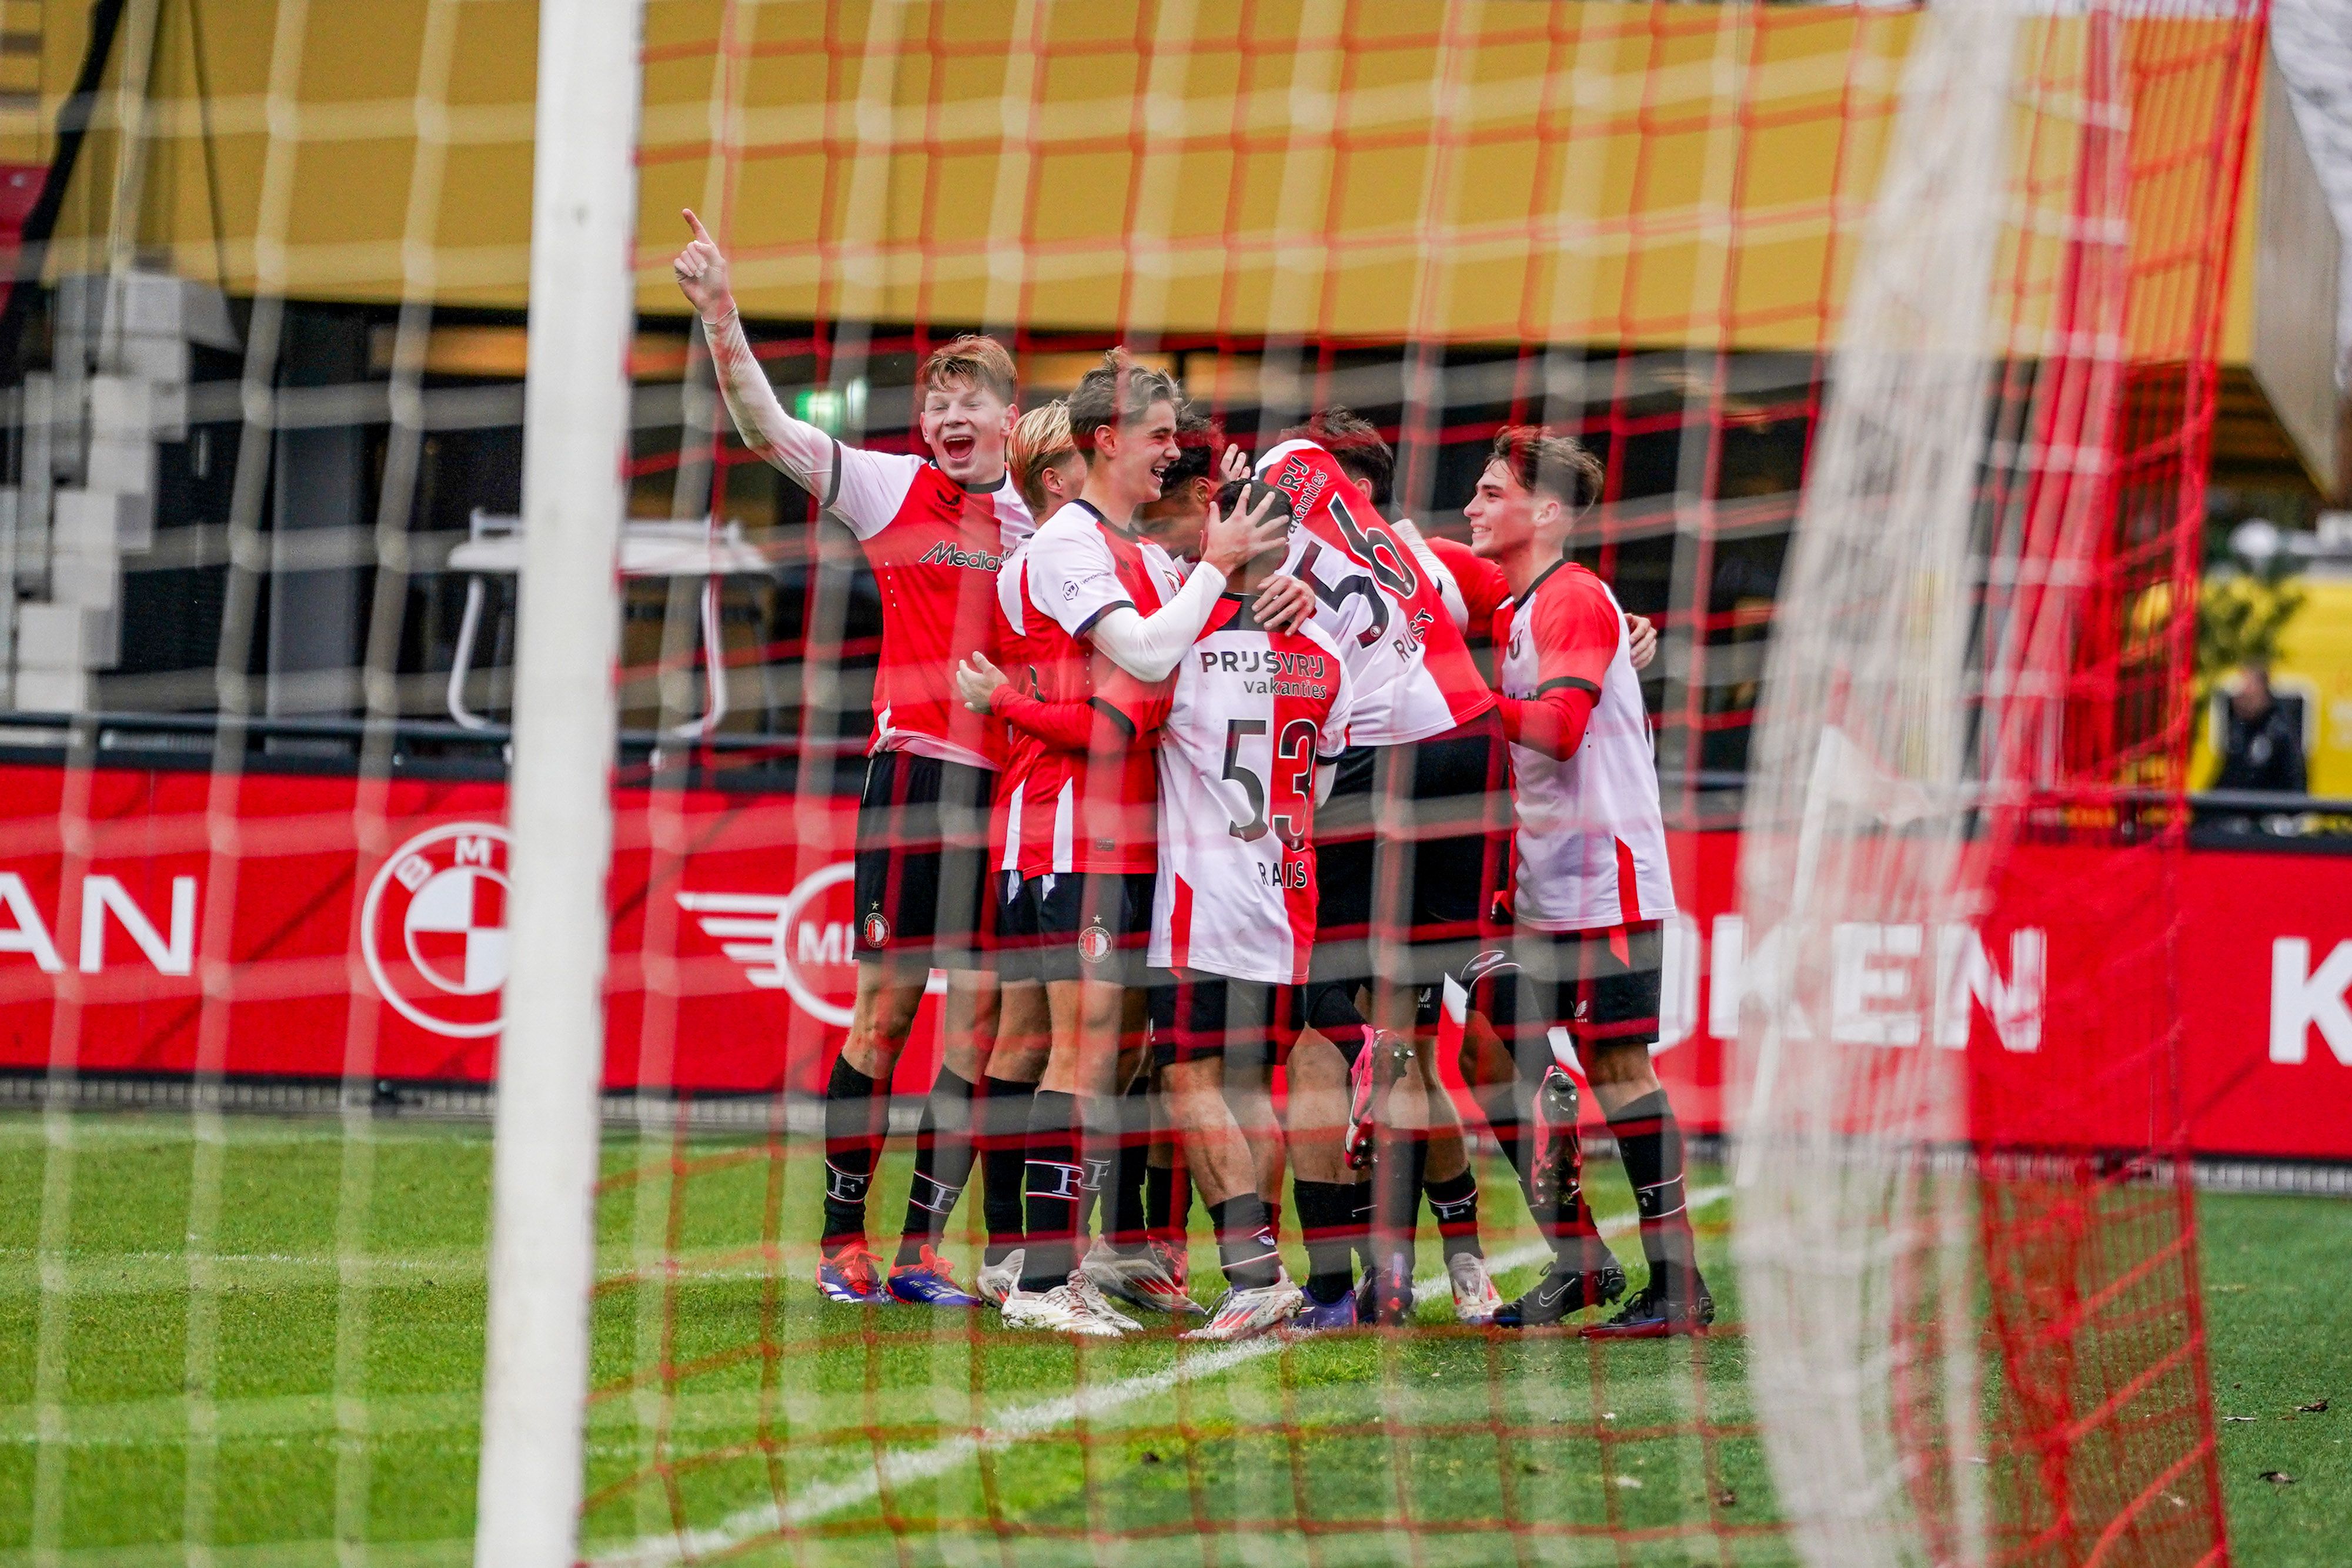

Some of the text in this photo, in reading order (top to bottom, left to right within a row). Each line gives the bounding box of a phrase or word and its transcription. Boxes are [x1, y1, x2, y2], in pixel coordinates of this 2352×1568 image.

[1288, 469, 1327, 534] akanties
[1065, 585, 1075, 596] LYB
[1292, 492, 1417, 649] 56
[1392, 608, 1434, 663] RUST
[1244, 677, 1327, 700] vakanties
[1221, 718, 1318, 851] 53
[393, 837, 492, 893] BM
[1258, 861, 1308, 888] RAIS
